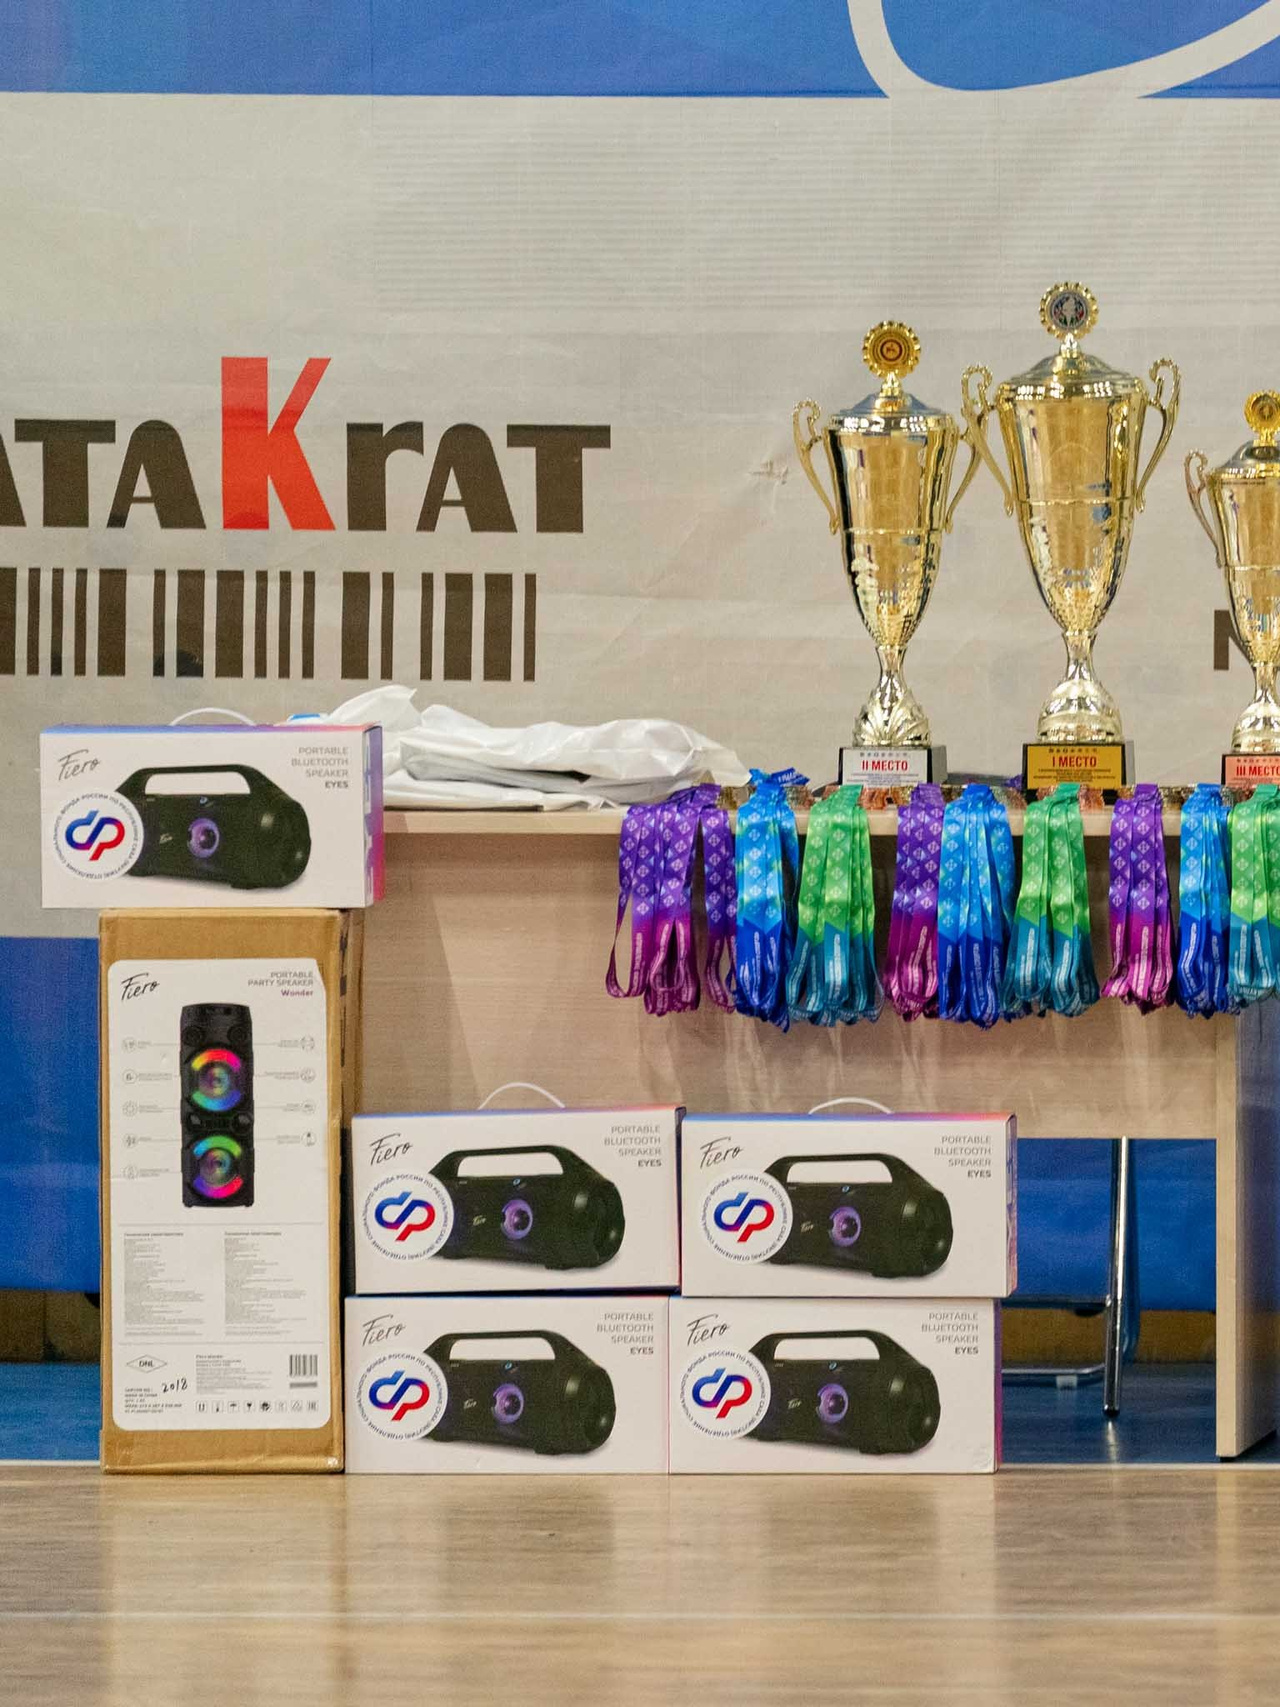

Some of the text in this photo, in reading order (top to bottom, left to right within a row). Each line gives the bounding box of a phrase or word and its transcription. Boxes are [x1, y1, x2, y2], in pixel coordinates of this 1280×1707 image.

[0, 356, 611, 533] TAKrAT
[298, 746, 349, 756] PORTABLE
[58, 749, 101, 782] Fiero
[291, 757, 349, 767] BLUETOOTH
[862, 760, 908, 772] II МЕСТО
[1058, 756, 1097, 768] МЕСТО
[305, 769, 349, 778] SPEAKER
[1236, 765, 1246, 776] III
[324, 780, 349, 789] EYES
[121, 972, 160, 1001] Fiero
[247, 979, 314, 987] PARTY SPEAKER
[280, 989, 314, 997] Wonder
[611, 1125, 661, 1135] PORTABLE
[603, 1136, 661, 1146] BLUETOOTH
[941, 1135, 991, 1144] PORTABLE
[369, 1132, 414, 1167] Fiero
[618, 1148, 662, 1157] SPEAKER
[699, 1136, 744, 1170] Fiero
[934, 1146, 992, 1155] BLUETOOTH
[637, 1159, 662, 1168] EYES
[948, 1158, 991, 1167] SPEAKER
[967, 1169, 992, 1178] EYES
[604, 1312, 654, 1321] PORTABLE
[928, 1312, 979, 1321] PORTABLE
[361, 1313, 407, 1348] Fiero
[596, 1323, 654, 1332] BLUETOOTH
[686, 1313, 731, 1347] Fiero
[920, 1323, 979, 1332] BLUETOOTH
[611, 1335, 654, 1344] SPEAKER
[935, 1335, 979, 1344] SPEAKER
[630, 1346, 654, 1355] EYES
[954, 1346, 979, 1355] EYES
